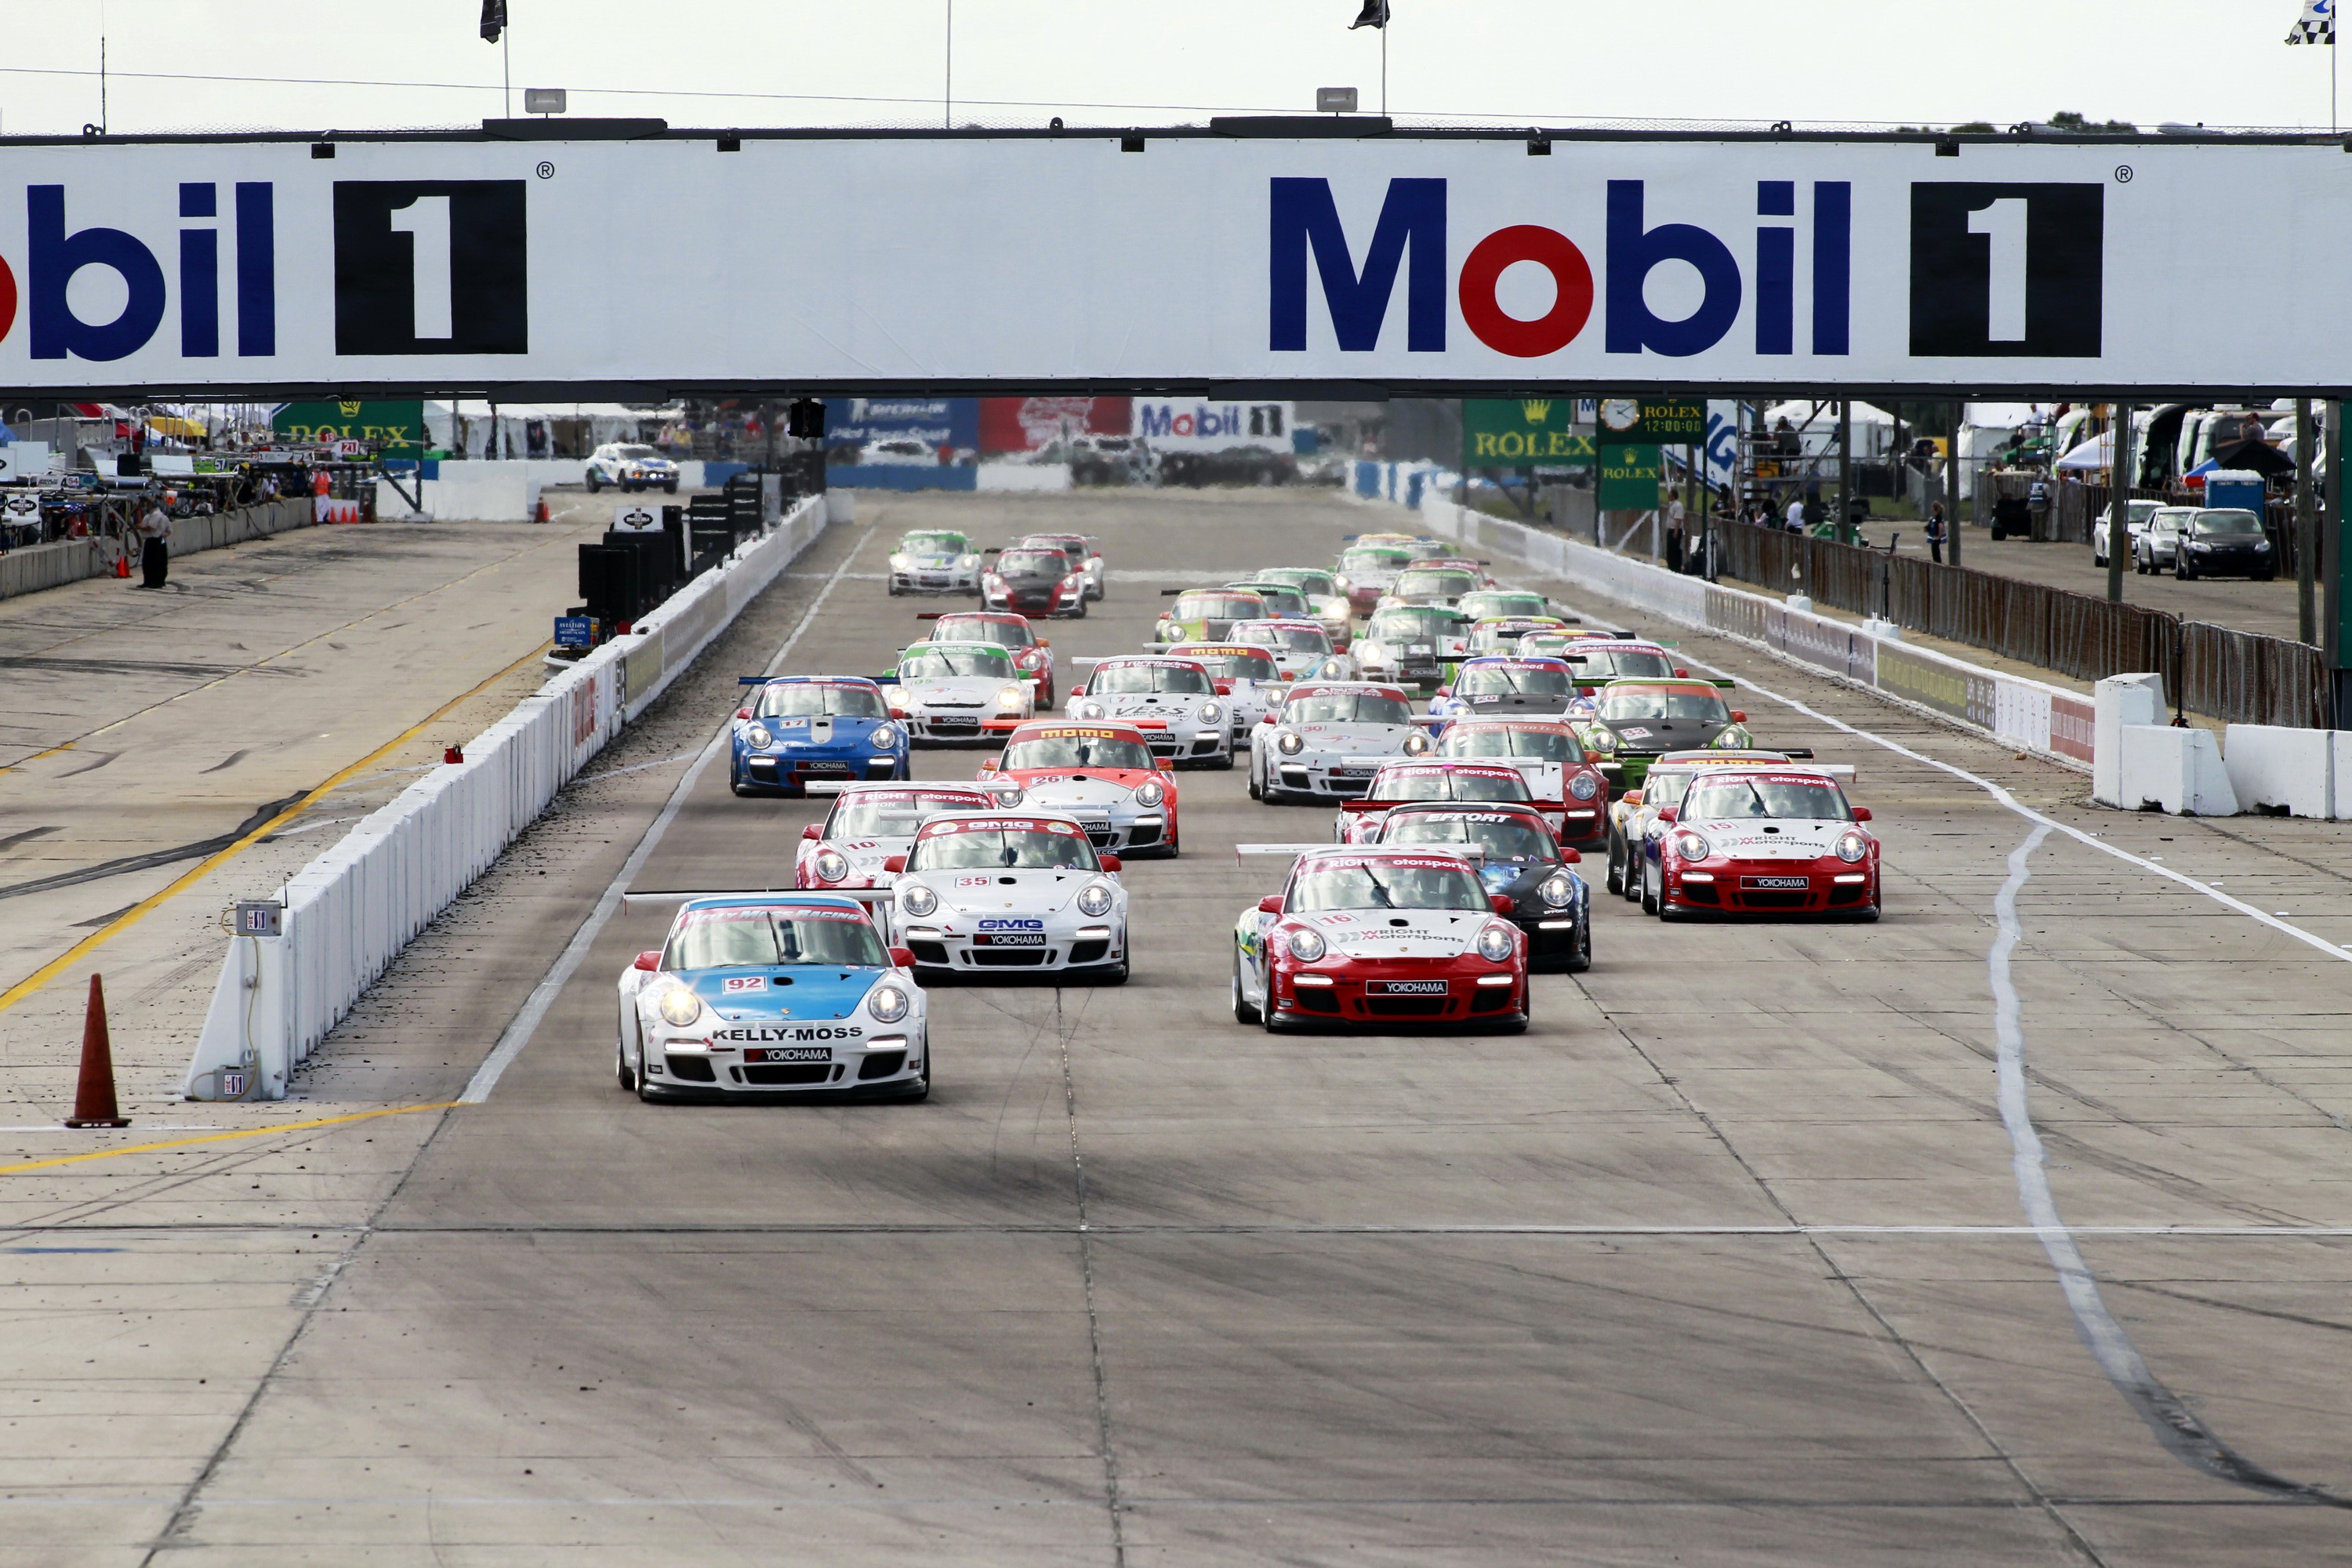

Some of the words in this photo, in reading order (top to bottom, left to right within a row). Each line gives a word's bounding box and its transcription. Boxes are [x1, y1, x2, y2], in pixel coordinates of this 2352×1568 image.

[0, 182, 275, 361] bil
[390, 195, 452, 339] 1
[1270, 177, 1851, 358] Mobil
[1967, 198, 2027, 341] 1
[1645, 406, 1701, 418] ROLEX
[1142, 403, 1240, 437] Mobil
[1645, 420, 1701, 432] 12:00:00
[343, 443, 355, 452] 21
[1475, 431, 1595, 458] ROLEX
[215, 459, 227, 470] 57
[1603, 467, 1657, 479] ROLEX
[1312, 687, 1382, 695] ANSA
[1116, 706, 1188, 715] VESS
[1040, 729, 1114, 739] momo
[1622, 728, 1647, 739] 33
[1425, 812, 1512, 823] EFFORT
[1081, 823, 1110, 832] OHAMA
[1706, 822, 1733, 831] 15
[846, 841, 877, 850] 10
[959, 877, 988, 887] 35
[1758, 877, 1806, 887] YOKOHAMA
[794, 909, 861, 921] RACING
[1320, 914, 1352, 924] 16
[978, 919, 1044, 929] GMG
[991, 935, 1044, 945] YOKOHAMA
[728, 978, 762, 990] 92
[1386, 982, 1444, 993] YOKOHAMA
[713, 1026, 863, 1041] KELLY-MOSS
[766, 1049, 829, 1060] YOKOHAMA
